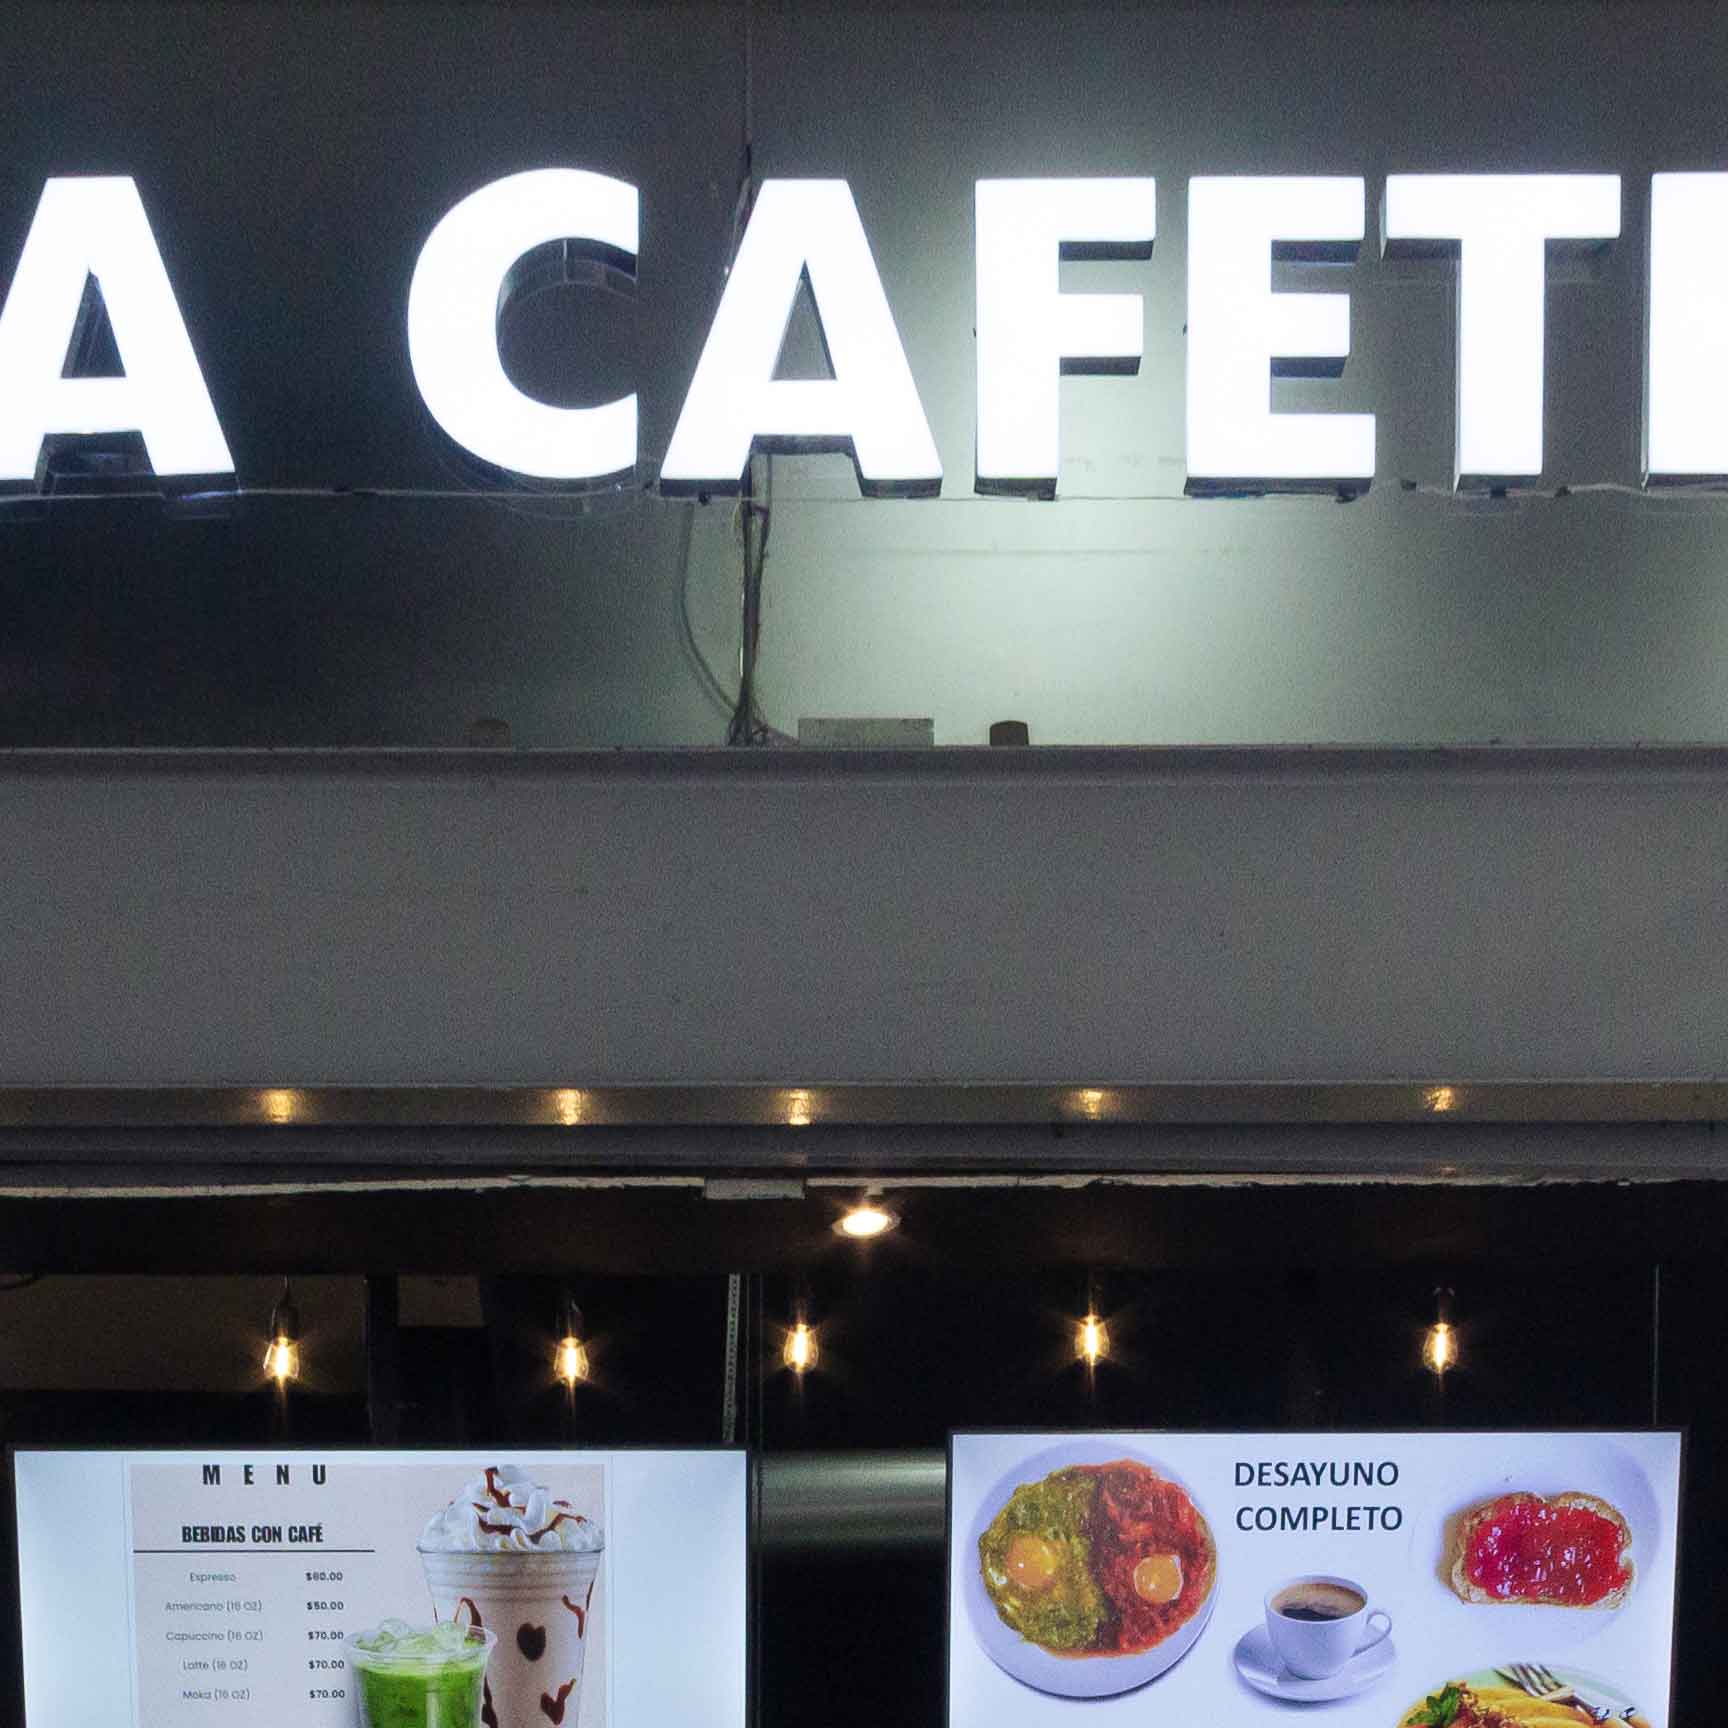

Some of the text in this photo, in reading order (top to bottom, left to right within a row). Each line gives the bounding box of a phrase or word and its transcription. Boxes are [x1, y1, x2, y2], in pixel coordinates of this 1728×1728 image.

[1234, 1461, 1400, 1488] DESAYUNO
[1235, 1505, 1403, 1532] COMPLETO
[181, 1521, 324, 1545] BEBIDAS CON CAFÉ
[189, 1571, 237, 1584] Expresso
[164, 1600, 225, 1612] Americano
[307, 1630, 345, 1642] $70.00
[183, 1659, 210, 1671] Latte
[308, 1659, 346, 1671] $70.00
[182, 1688, 211, 1701] Moka
[308, 1689, 346, 1700] $70.00
